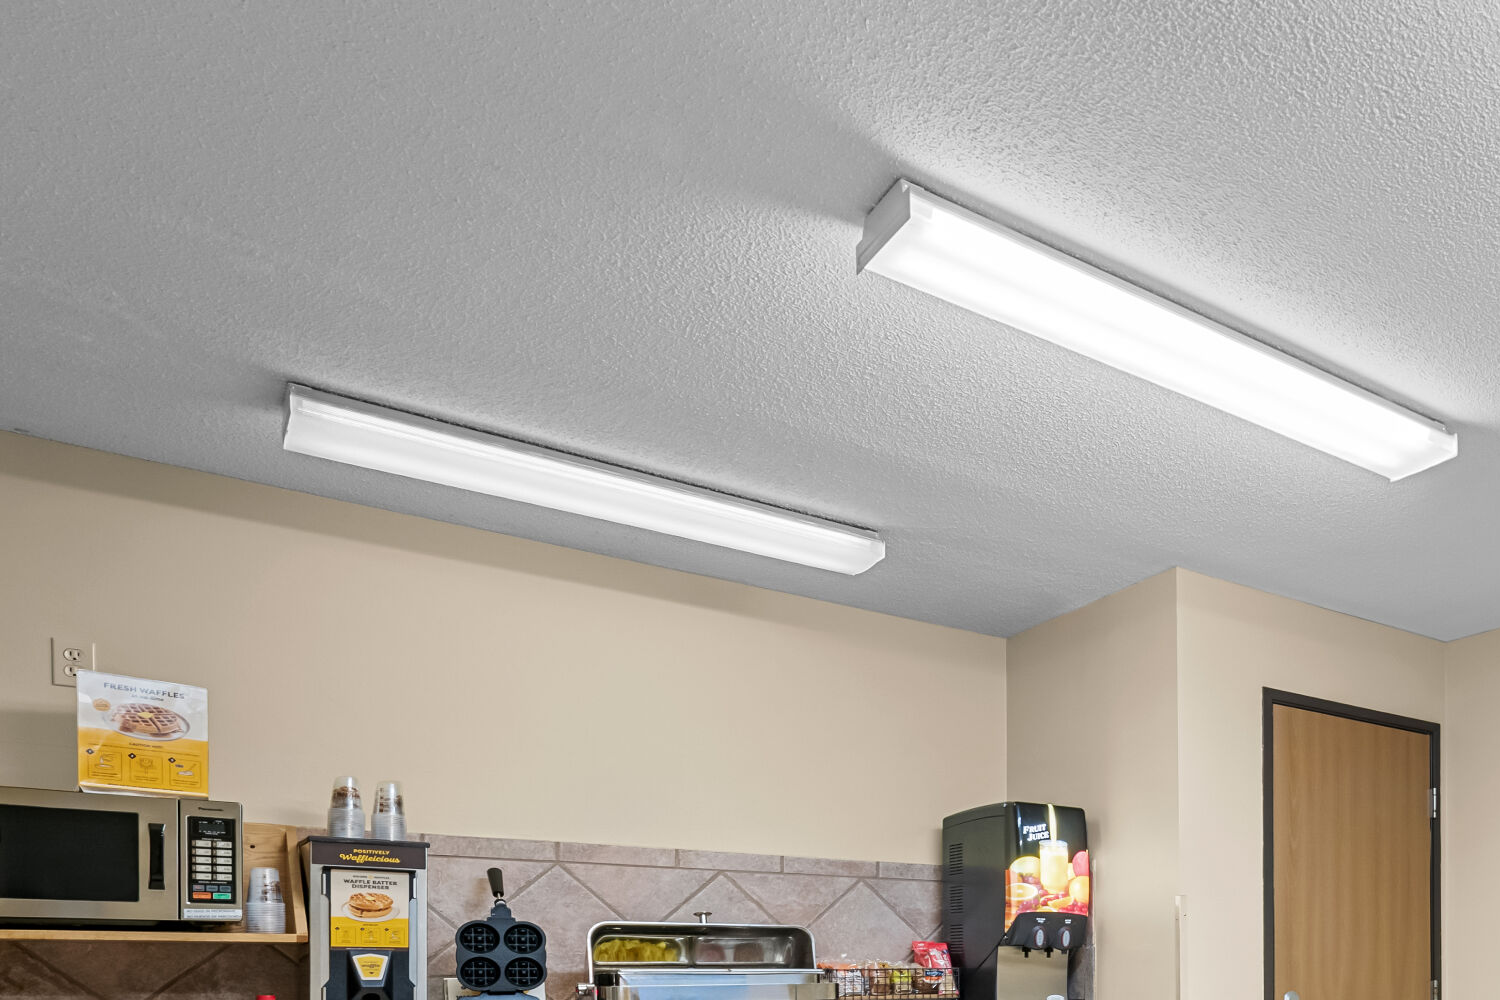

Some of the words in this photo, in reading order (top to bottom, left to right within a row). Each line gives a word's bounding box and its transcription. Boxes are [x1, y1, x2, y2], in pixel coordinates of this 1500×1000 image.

[103, 682, 137, 692] FRESH
[139, 687, 185, 700] WAFFLES
[1022, 823, 1047, 835] FRUIT
[1026, 831, 1050, 842] JUICE
[353, 848, 390, 856] POSITIVELY
